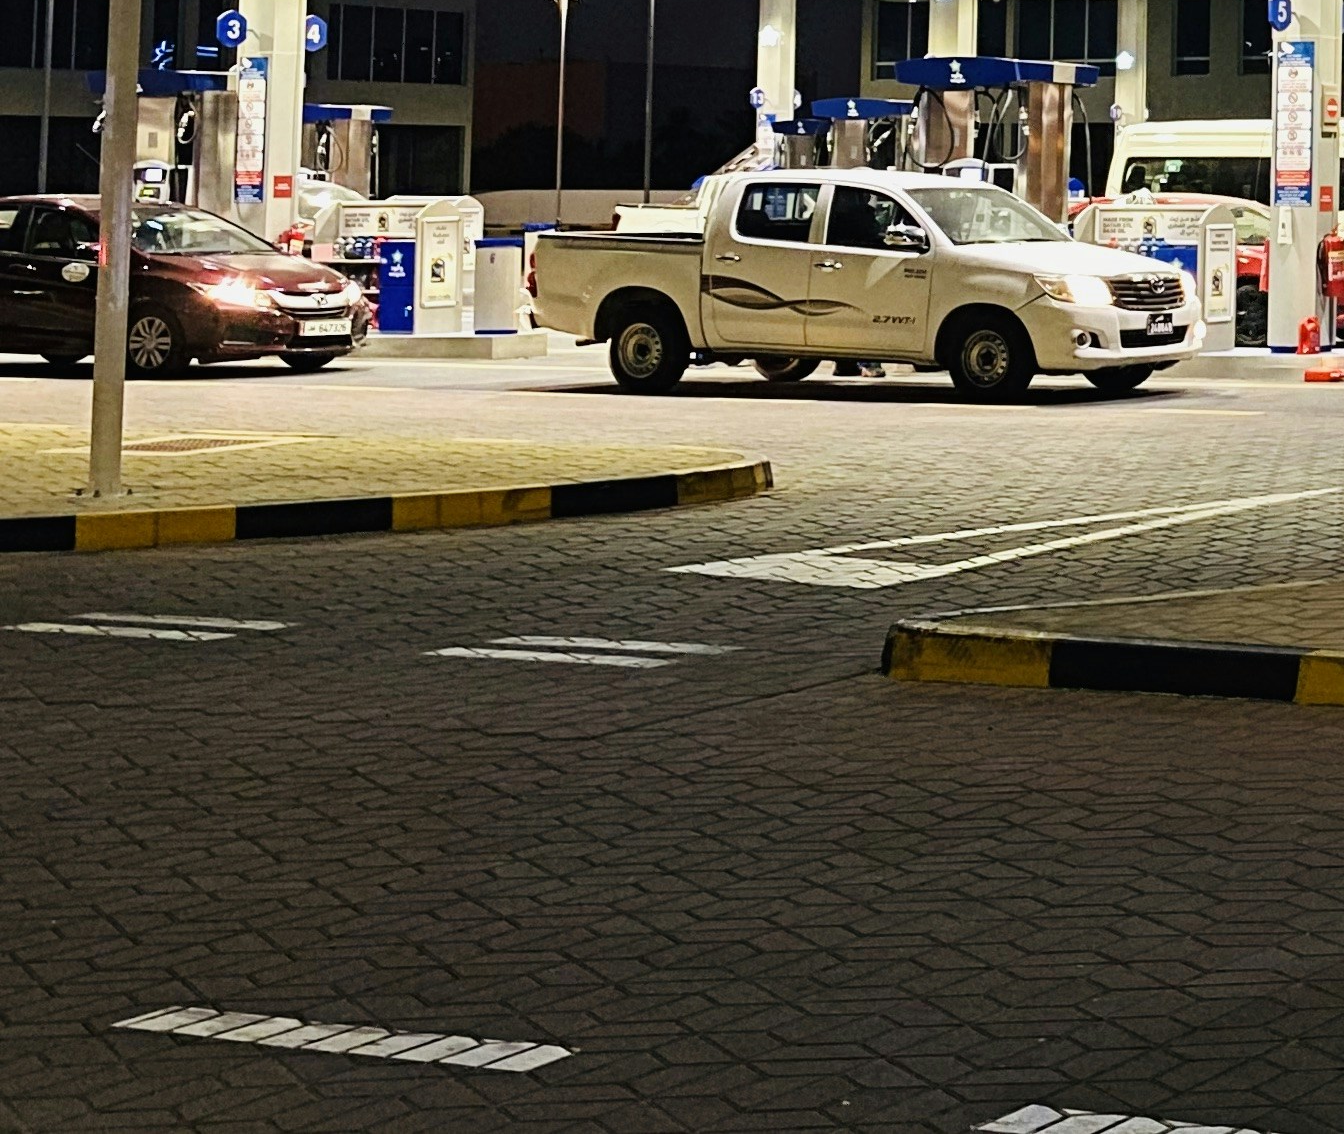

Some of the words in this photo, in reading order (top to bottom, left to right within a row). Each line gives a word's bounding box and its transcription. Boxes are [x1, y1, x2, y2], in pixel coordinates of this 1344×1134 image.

[1277, 0, 1288, 23] 5
[227, 19, 241, 40] 3
[306, 24, 321, 44] 4
